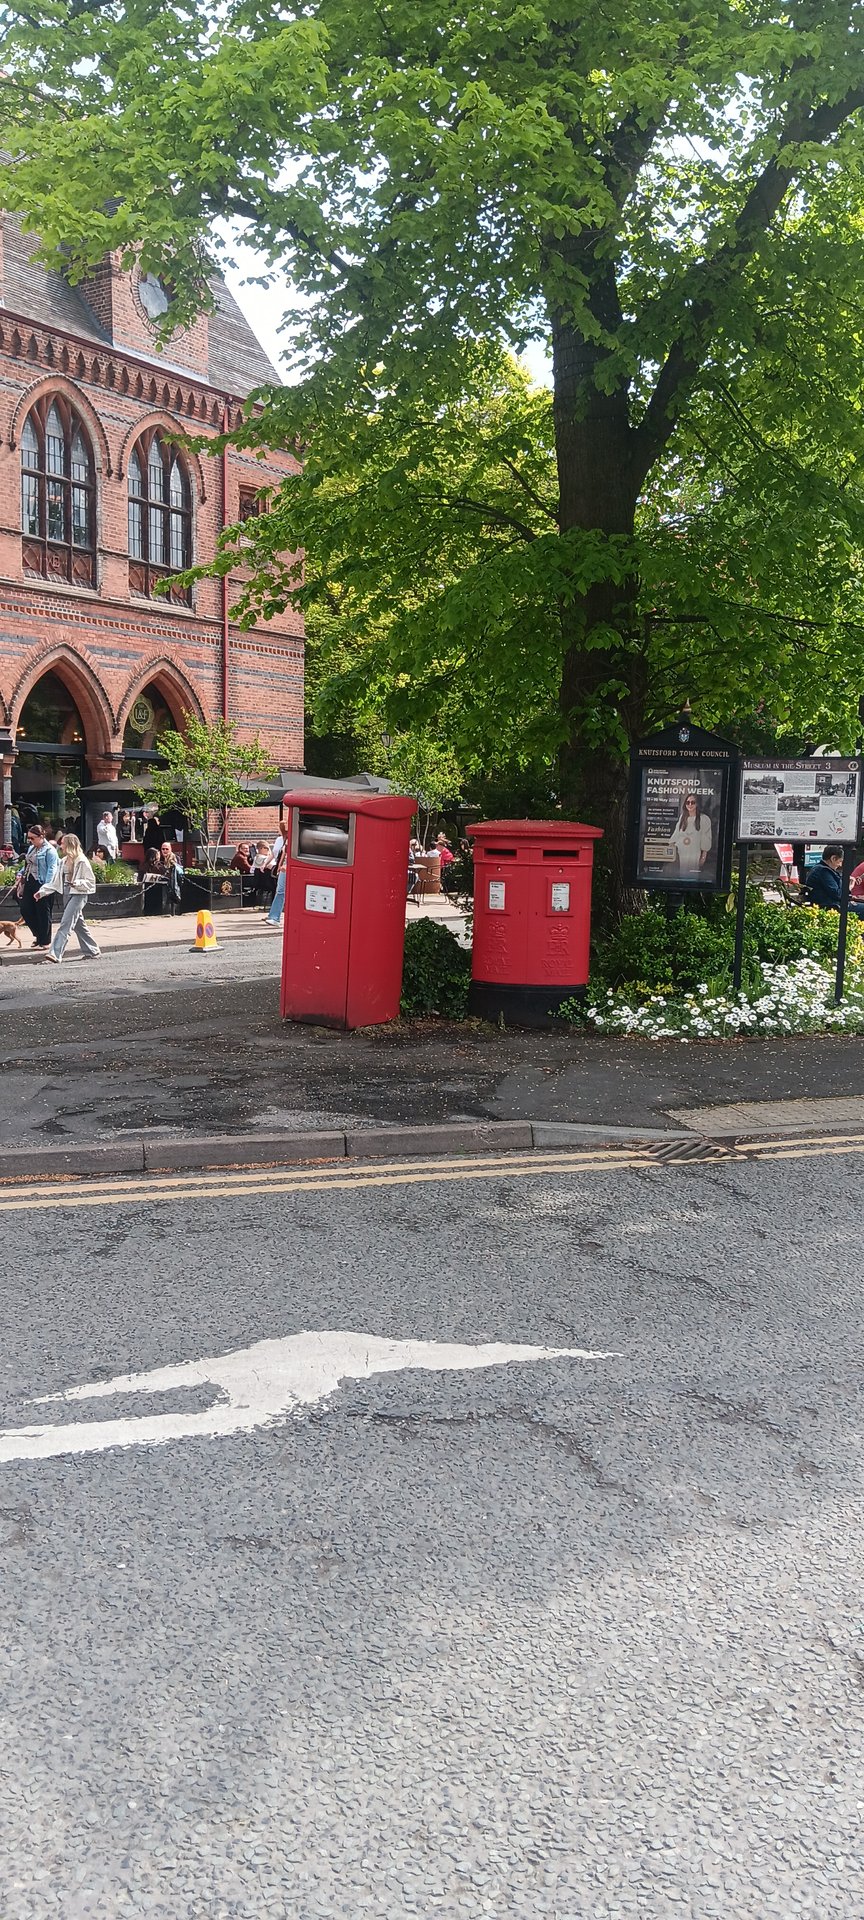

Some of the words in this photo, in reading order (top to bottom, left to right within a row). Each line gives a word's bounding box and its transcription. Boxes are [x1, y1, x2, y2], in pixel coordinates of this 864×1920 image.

[639, 749, 677, 757] KNUTSFORD
[702, 750, 730, 758] COUNCIL
[825, 762, 831, 770] 3
[647, 778, 700, 786] KNUTSFORD
[646, 786, 685, 795] FASHION
[687, 787, 714, 796] WEEK
